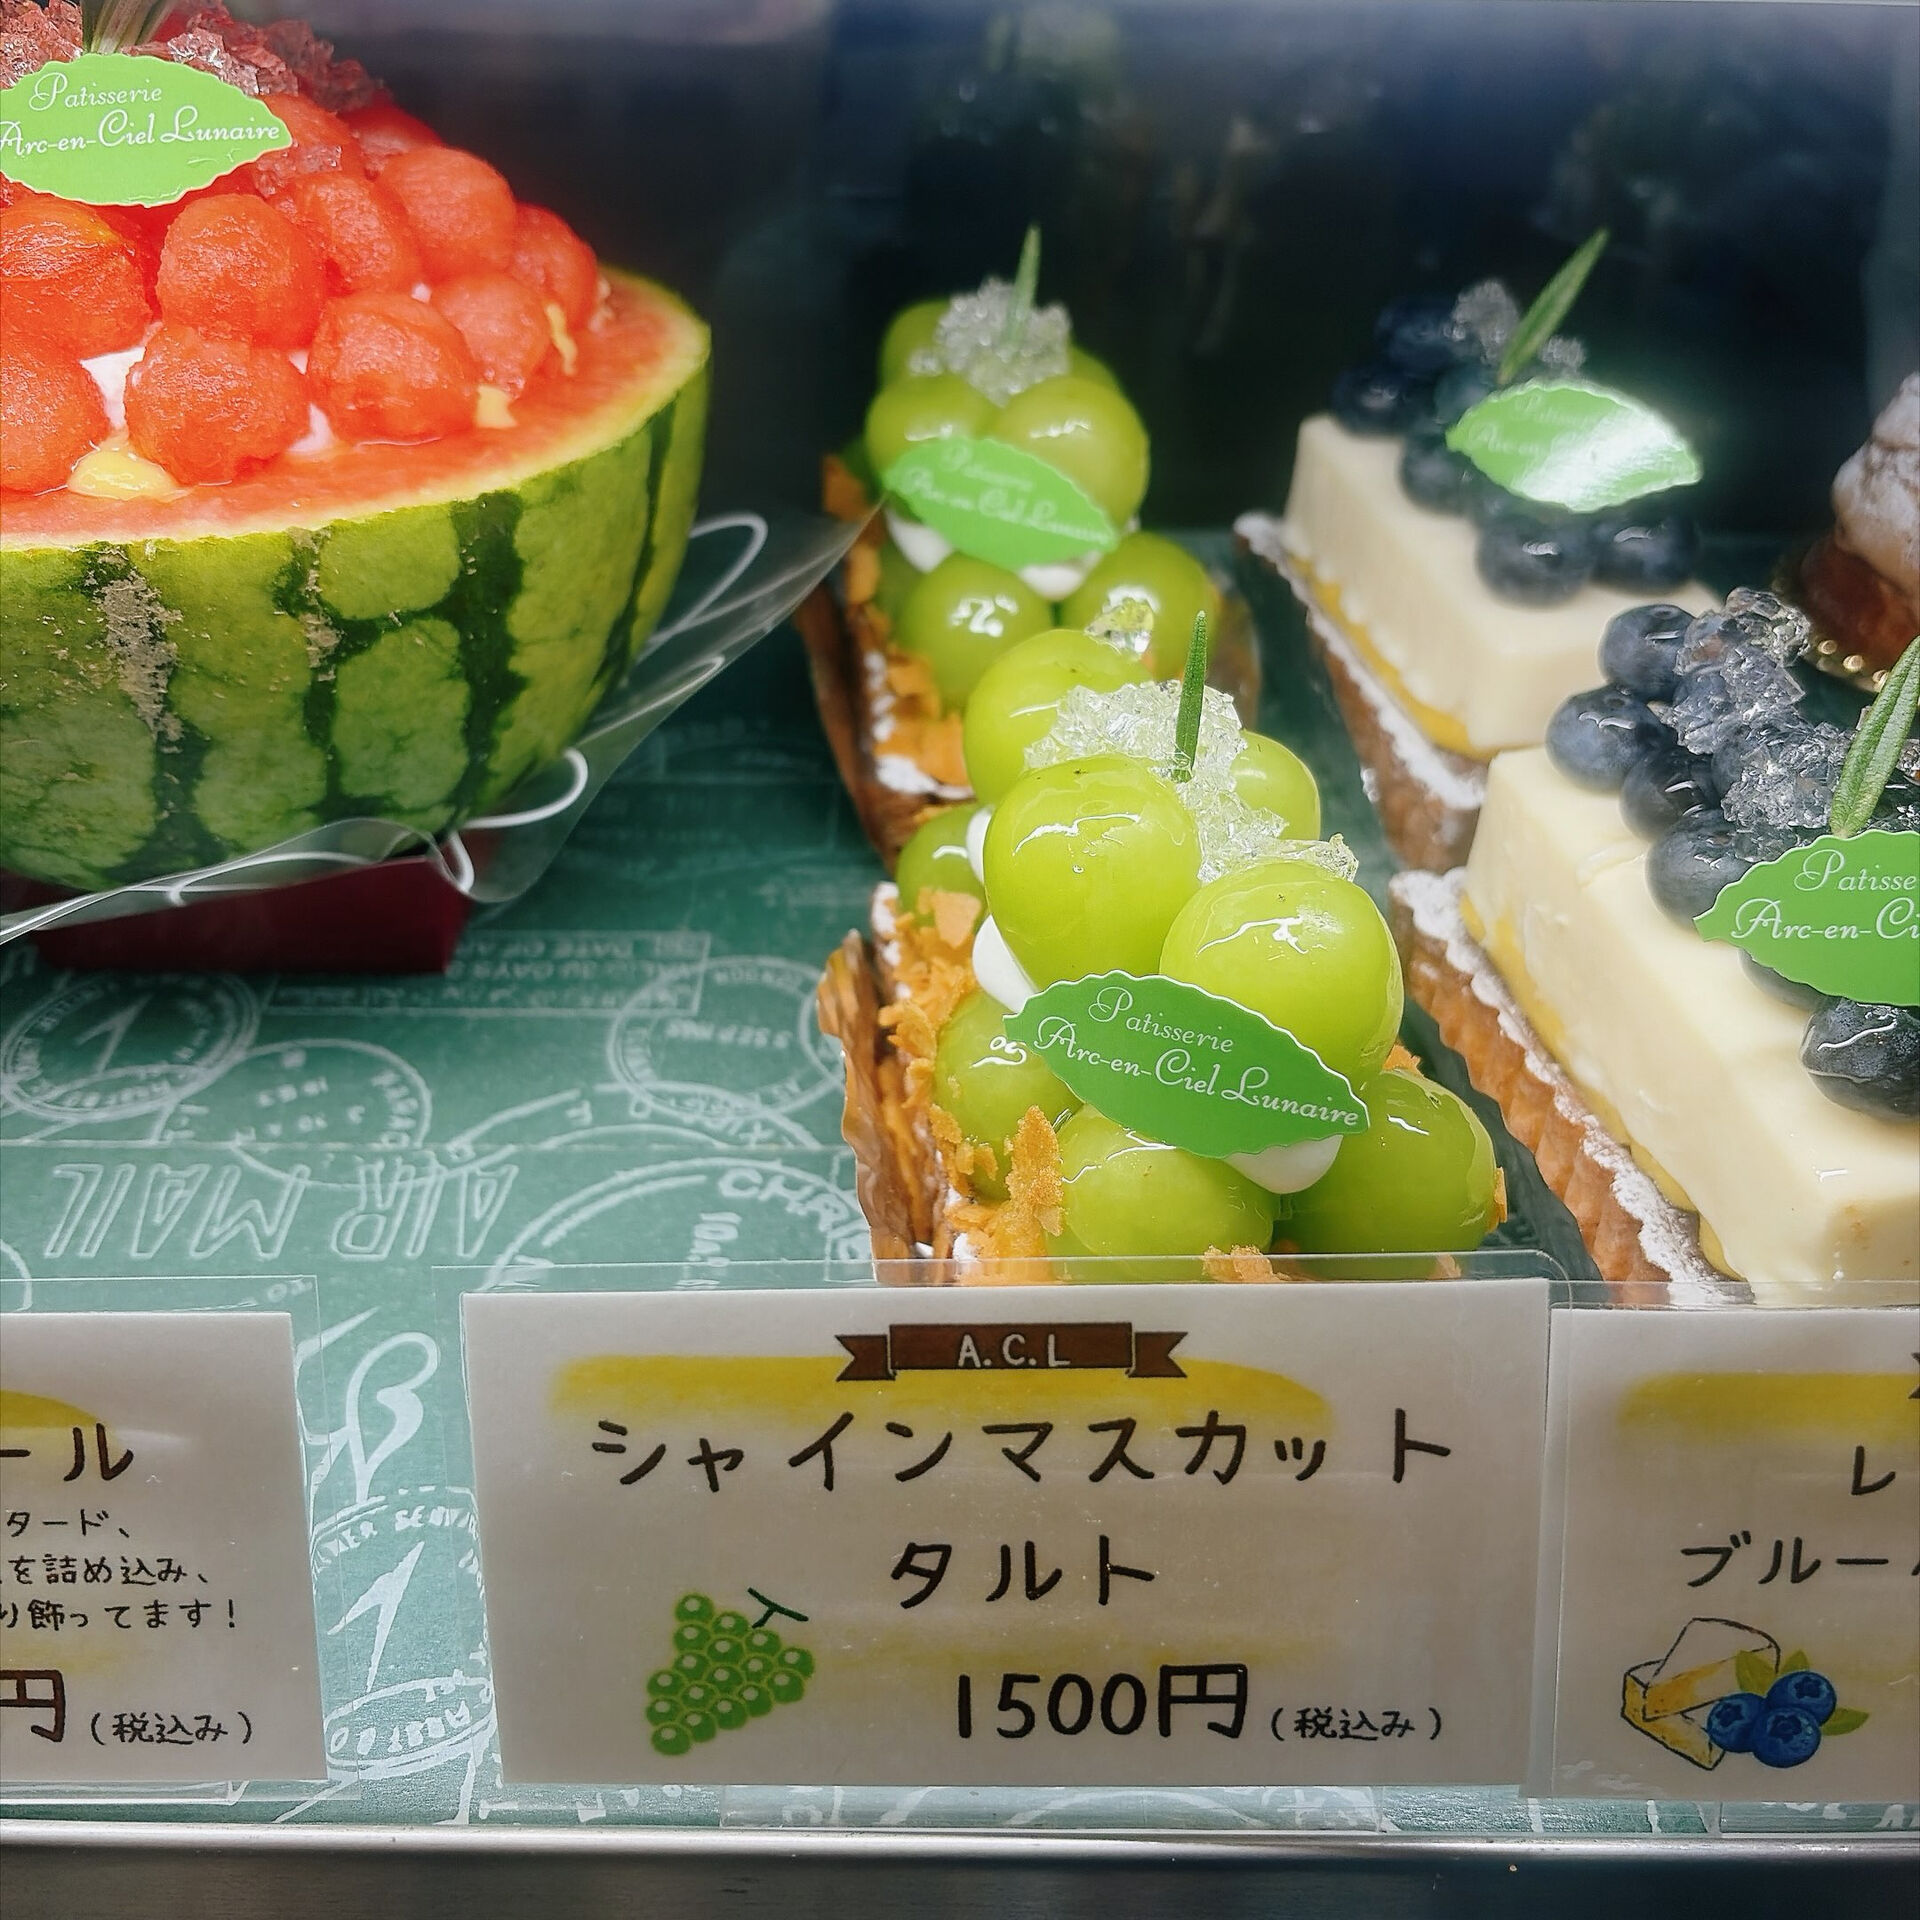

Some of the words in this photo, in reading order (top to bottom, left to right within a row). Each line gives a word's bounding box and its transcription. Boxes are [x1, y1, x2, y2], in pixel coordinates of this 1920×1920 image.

[29, 72, 162, 111] Patisserie
[0, 109, 155, 156] Arc-en-Ciel
[160, 105, 280, 142] Lunaire
[1088, 985, 1236, 1053] Patisserie
[1033, 1015, 1217, 1096] Arc-en-Ciel
[1221, 1065, 1360, 1127] Lunaire
[44, 1163, 311, 1260] MAIL
[958, 1333, 1071, 1368] A.C.L
[592, 1407, 1451, 1492] シャインマスカット
[1851, 1445, 1896, 1496] レ
[0, 1553, 208, 1586] を詰め込み、
[890, 1535, 1155, 1609] タルト
[1681, 1530, 1920, 1588] ブルー
[91, 1711, 252, 1746] (税込み)
[958, 1663, 1249, 1739] 1500円
[1271, 1706, 1443, 1741] (税込み)
